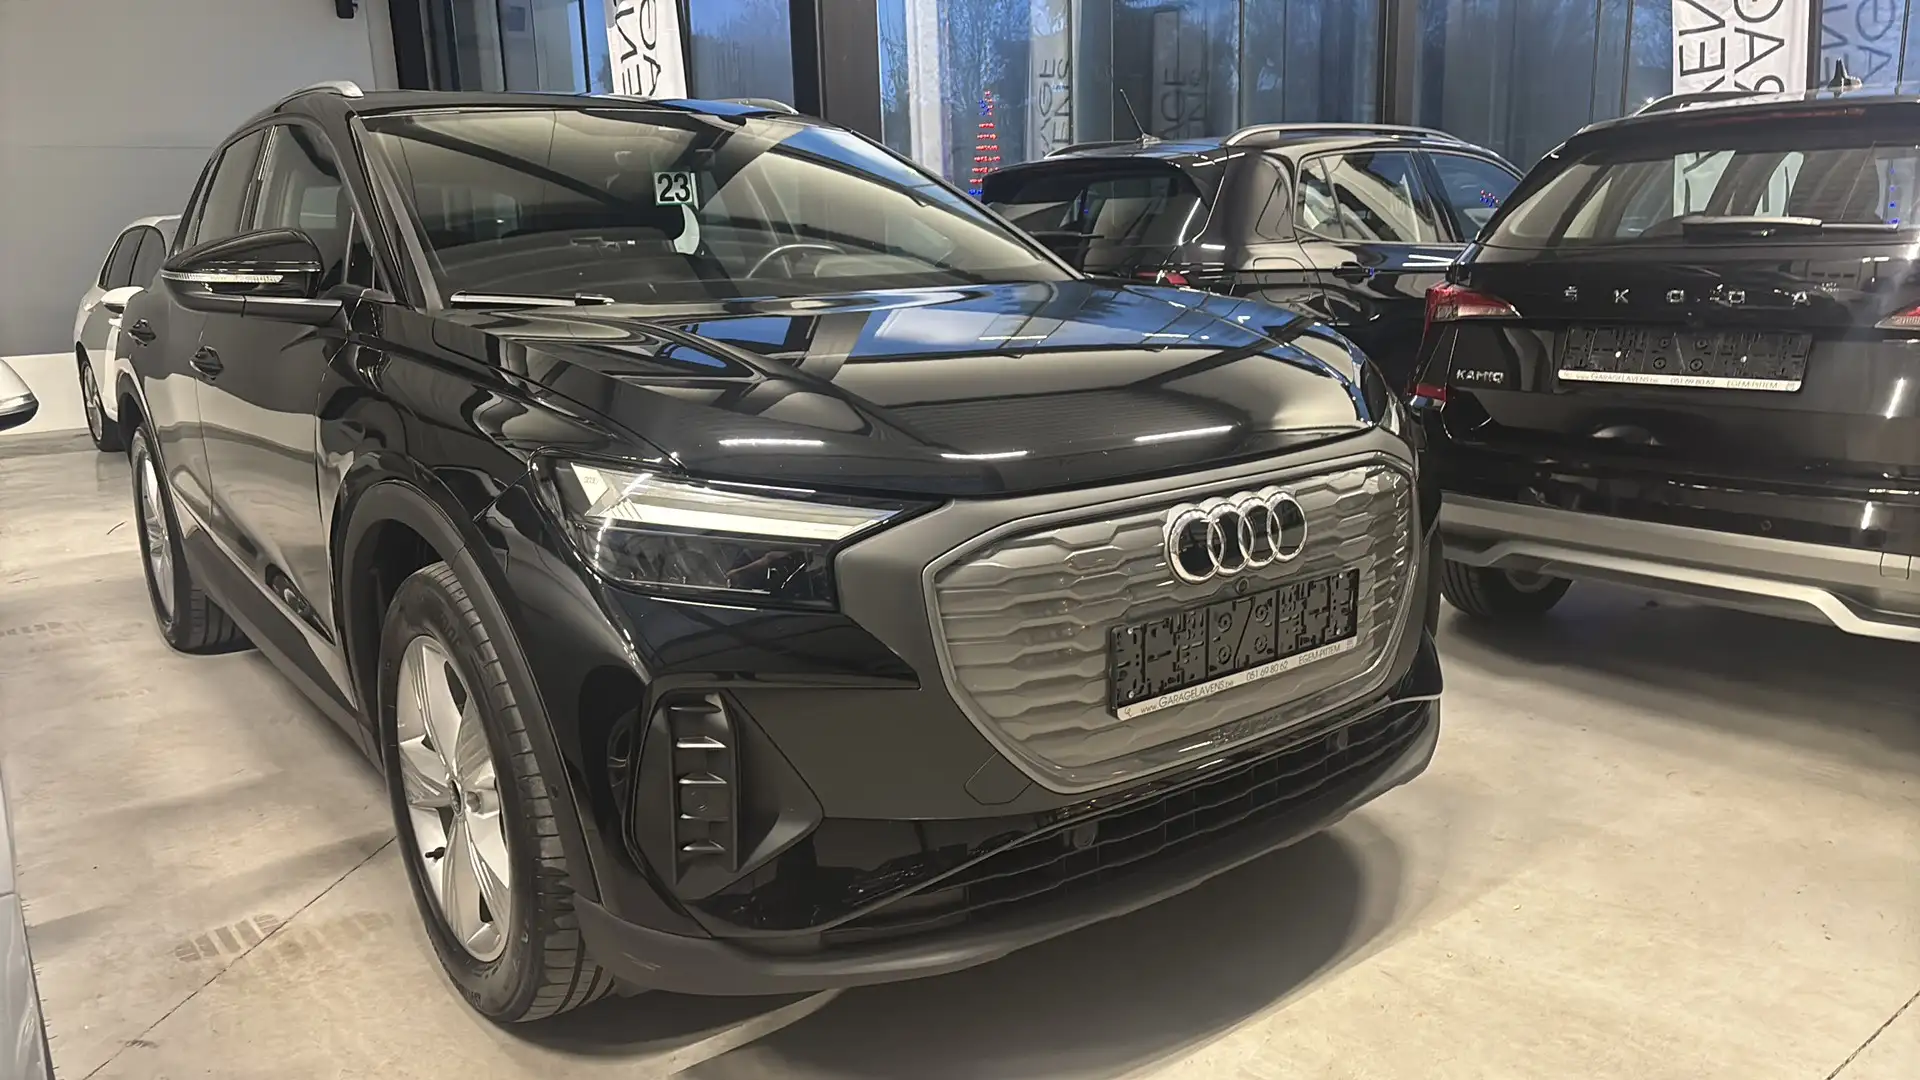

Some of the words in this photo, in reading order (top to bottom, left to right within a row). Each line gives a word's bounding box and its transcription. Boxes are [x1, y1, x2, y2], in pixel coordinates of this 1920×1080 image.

[657, 173, 691, 202] 23
[1456, 369, 1504, 383] KAMIQ
[1246, 670, 1259, 681] 051
[1260, 667, 1270, 677] 69
[1270, 664, 1279, 674] 80
[1279, 661, 1289, 671] 62
